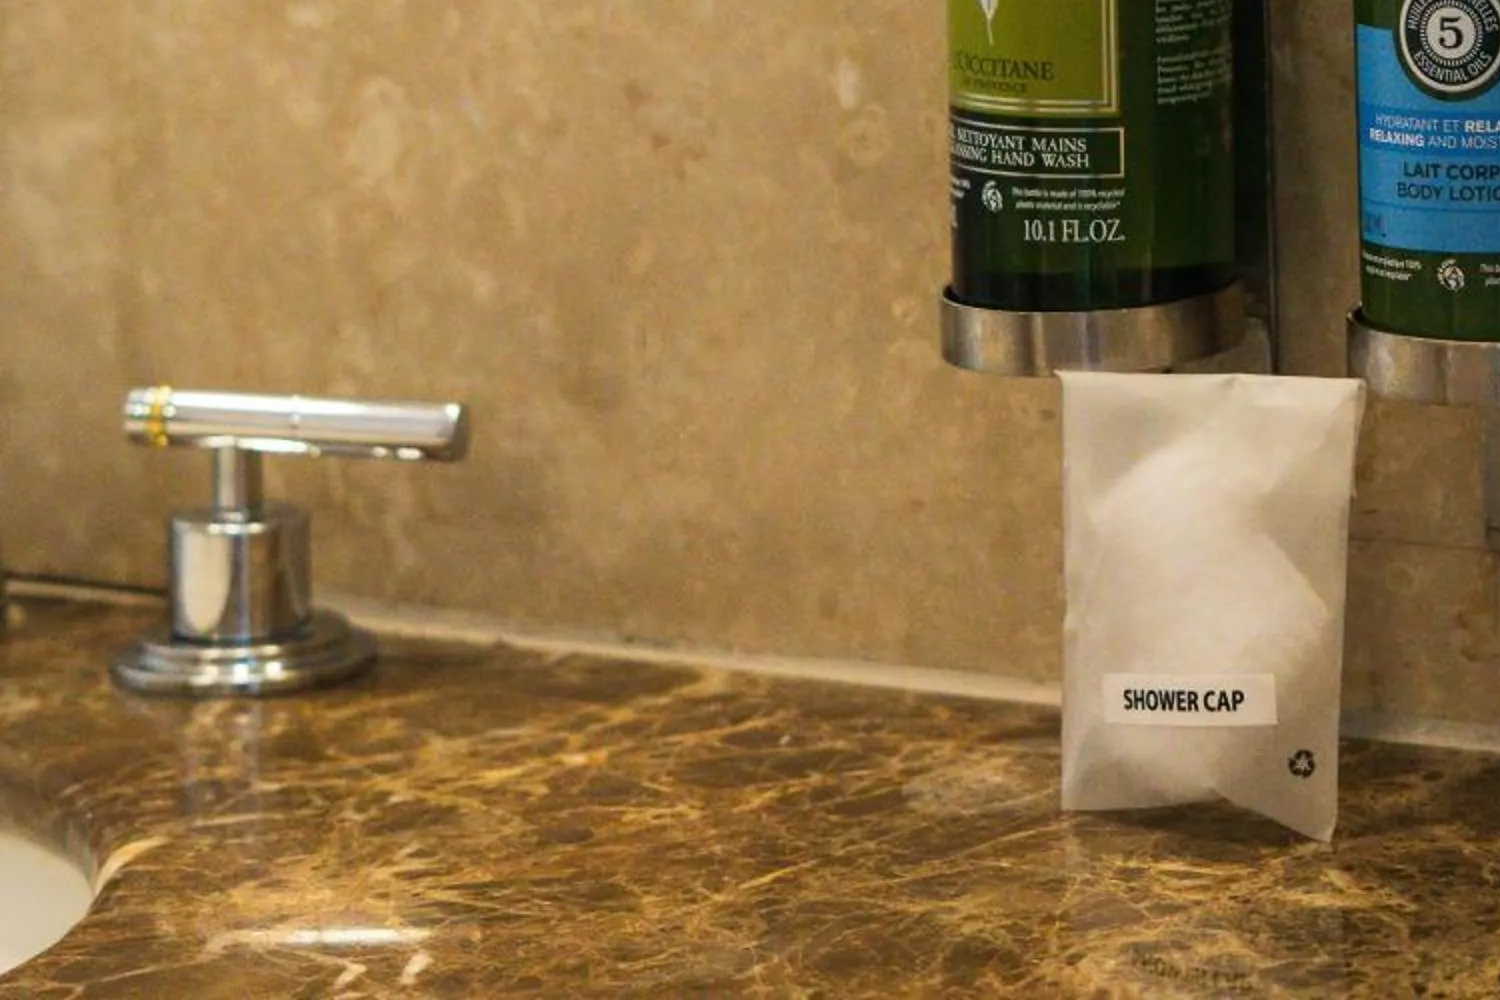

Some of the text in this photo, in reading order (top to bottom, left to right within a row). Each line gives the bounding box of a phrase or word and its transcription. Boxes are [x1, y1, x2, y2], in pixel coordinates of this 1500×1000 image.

[1439, 16, 1463, 49] 5
[1414, 50, 1493, 83] ESSENTIAL OILS
[1375, 114, 1438, 132] HYDRATANT
[1443, 119, 1460, 133] ET
[1032, 137, 1087, 153] MAINS
[1369, 127, 1424, 147] RELAXING
[1428, 135, 1456, 149] AND
[992, 149, 1035, 168] HAND
[1042, 152, 1089, 169] WASH
[1404, 161, 1442, 179] LAIT
[1397, 181, 1443, 200] BODY
[1024, 219, 1055, 241] 10.1
[1123, 688, 1245, 712] SHOWER CAP
